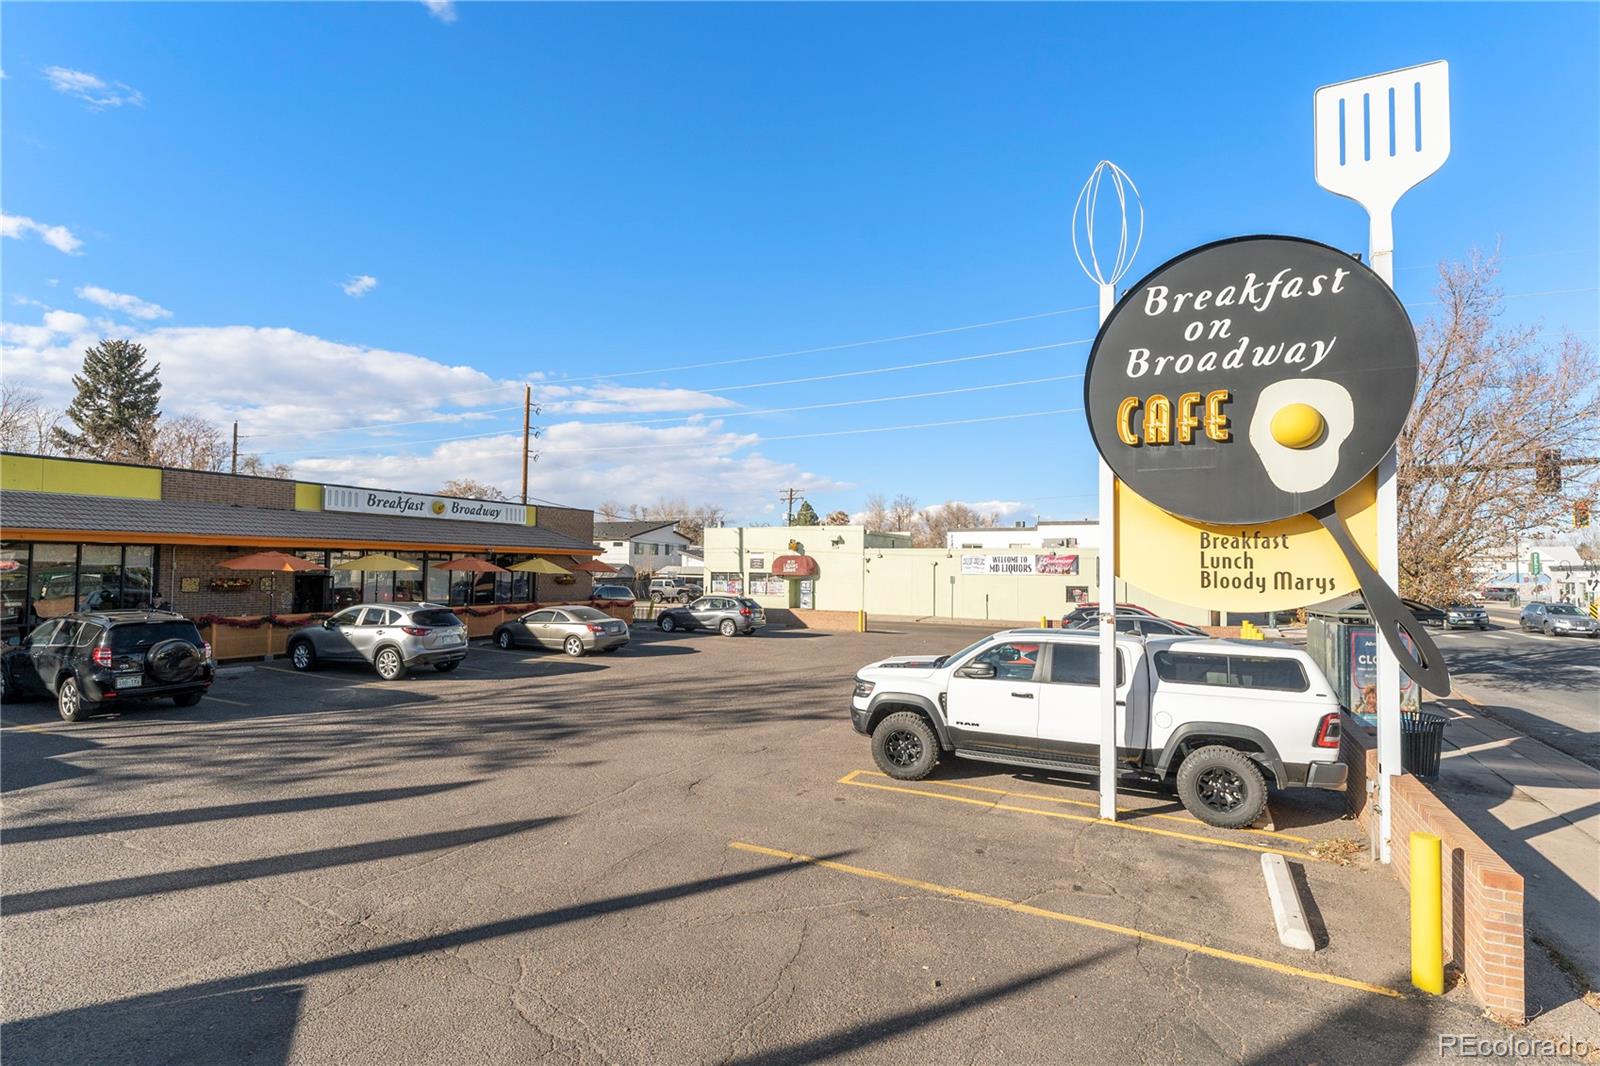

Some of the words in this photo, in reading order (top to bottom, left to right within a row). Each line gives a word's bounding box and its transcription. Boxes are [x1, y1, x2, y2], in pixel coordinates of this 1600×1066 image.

[1144, 267, 1350, 317] Breakfast
[1185, 319, 1232, 342] on
[1126, 336, 1337, 378] Broadway
[1116, 389, 1230, 446] CAFE
[367, 493, 425, 513] Breakfast
[451, 501, 502, 520] Broadway
[1200, 531, 1289, 550] Breakfast
[989, 564, 1000, 573] MD
[1001, 564, 1032, 574] LIQUORS
[1200, 551, 1254, 569] Lunch
[1200, 571, 1266, 594] Bloody
[1273, 571, 1336, 595] Marys
